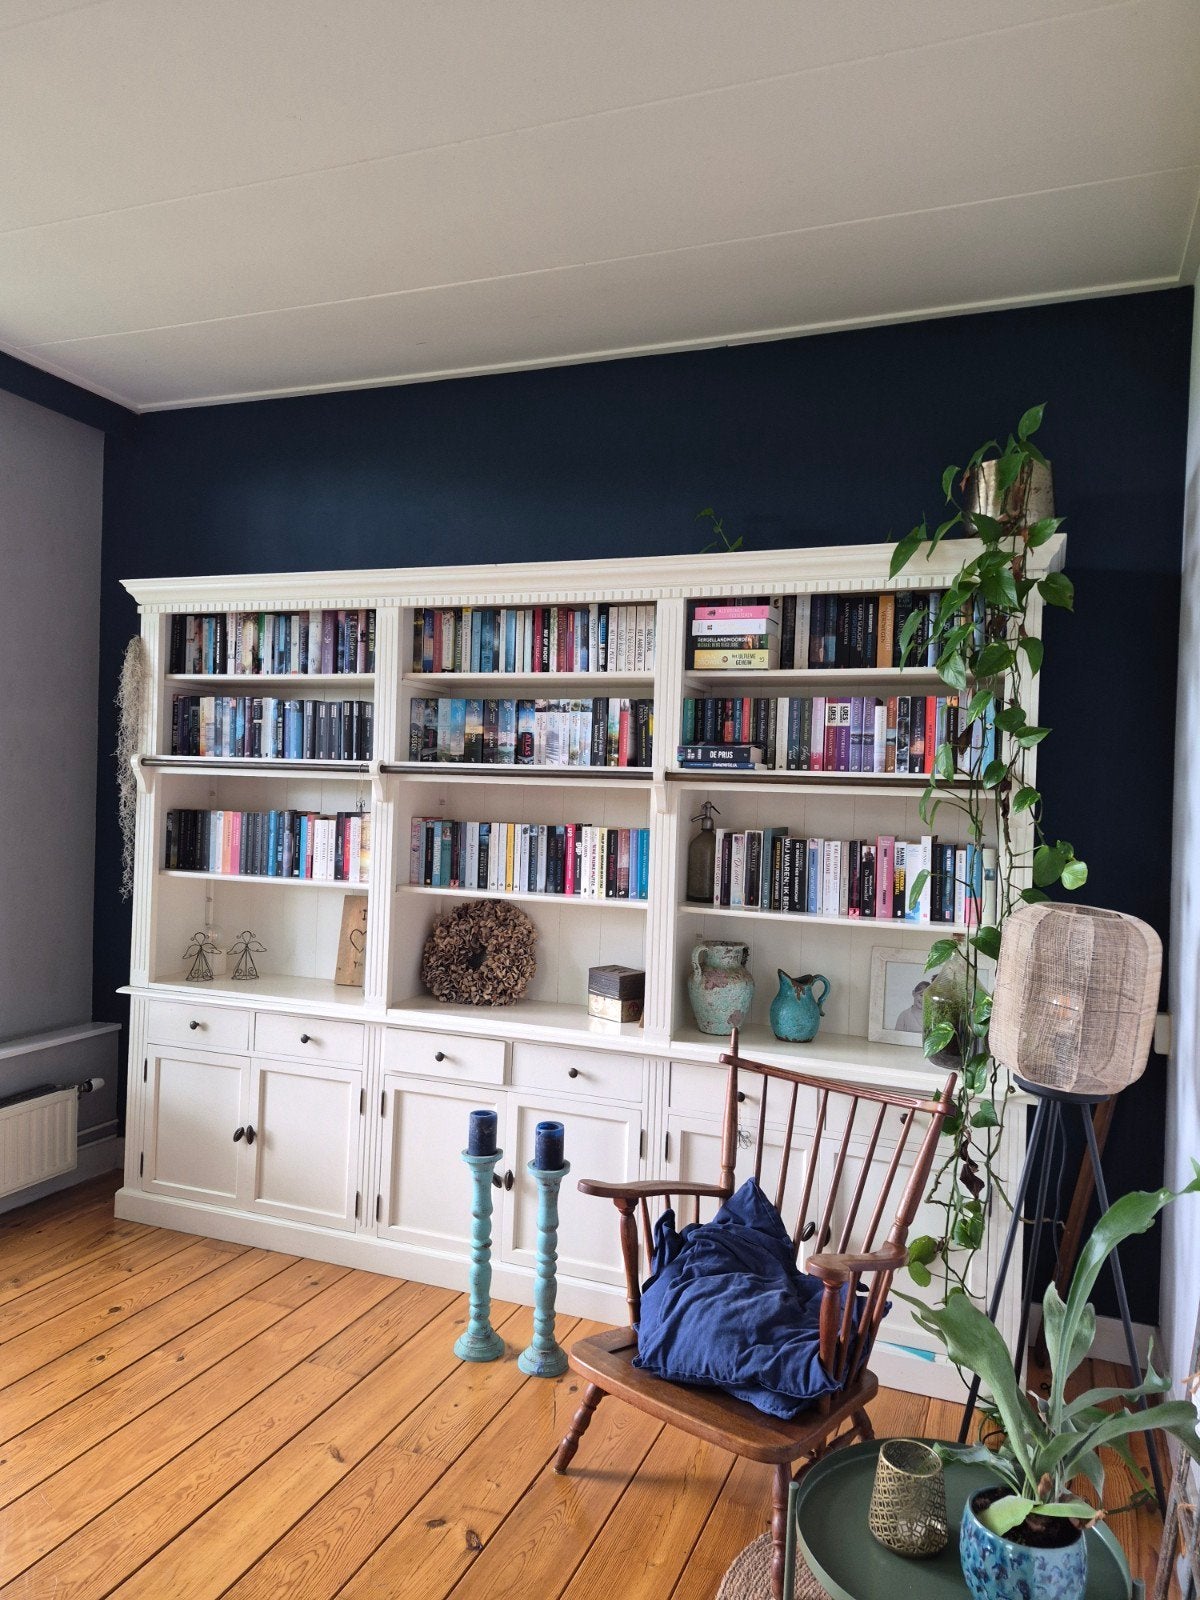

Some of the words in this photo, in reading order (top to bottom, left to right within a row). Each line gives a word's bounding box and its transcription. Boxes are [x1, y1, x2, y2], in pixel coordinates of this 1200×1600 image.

[543, 628, 549, 637] NU
[543, 637, 549, 646] OF
[709, 751, 718, 759] DE
[783, 886, 790, 894] IK
